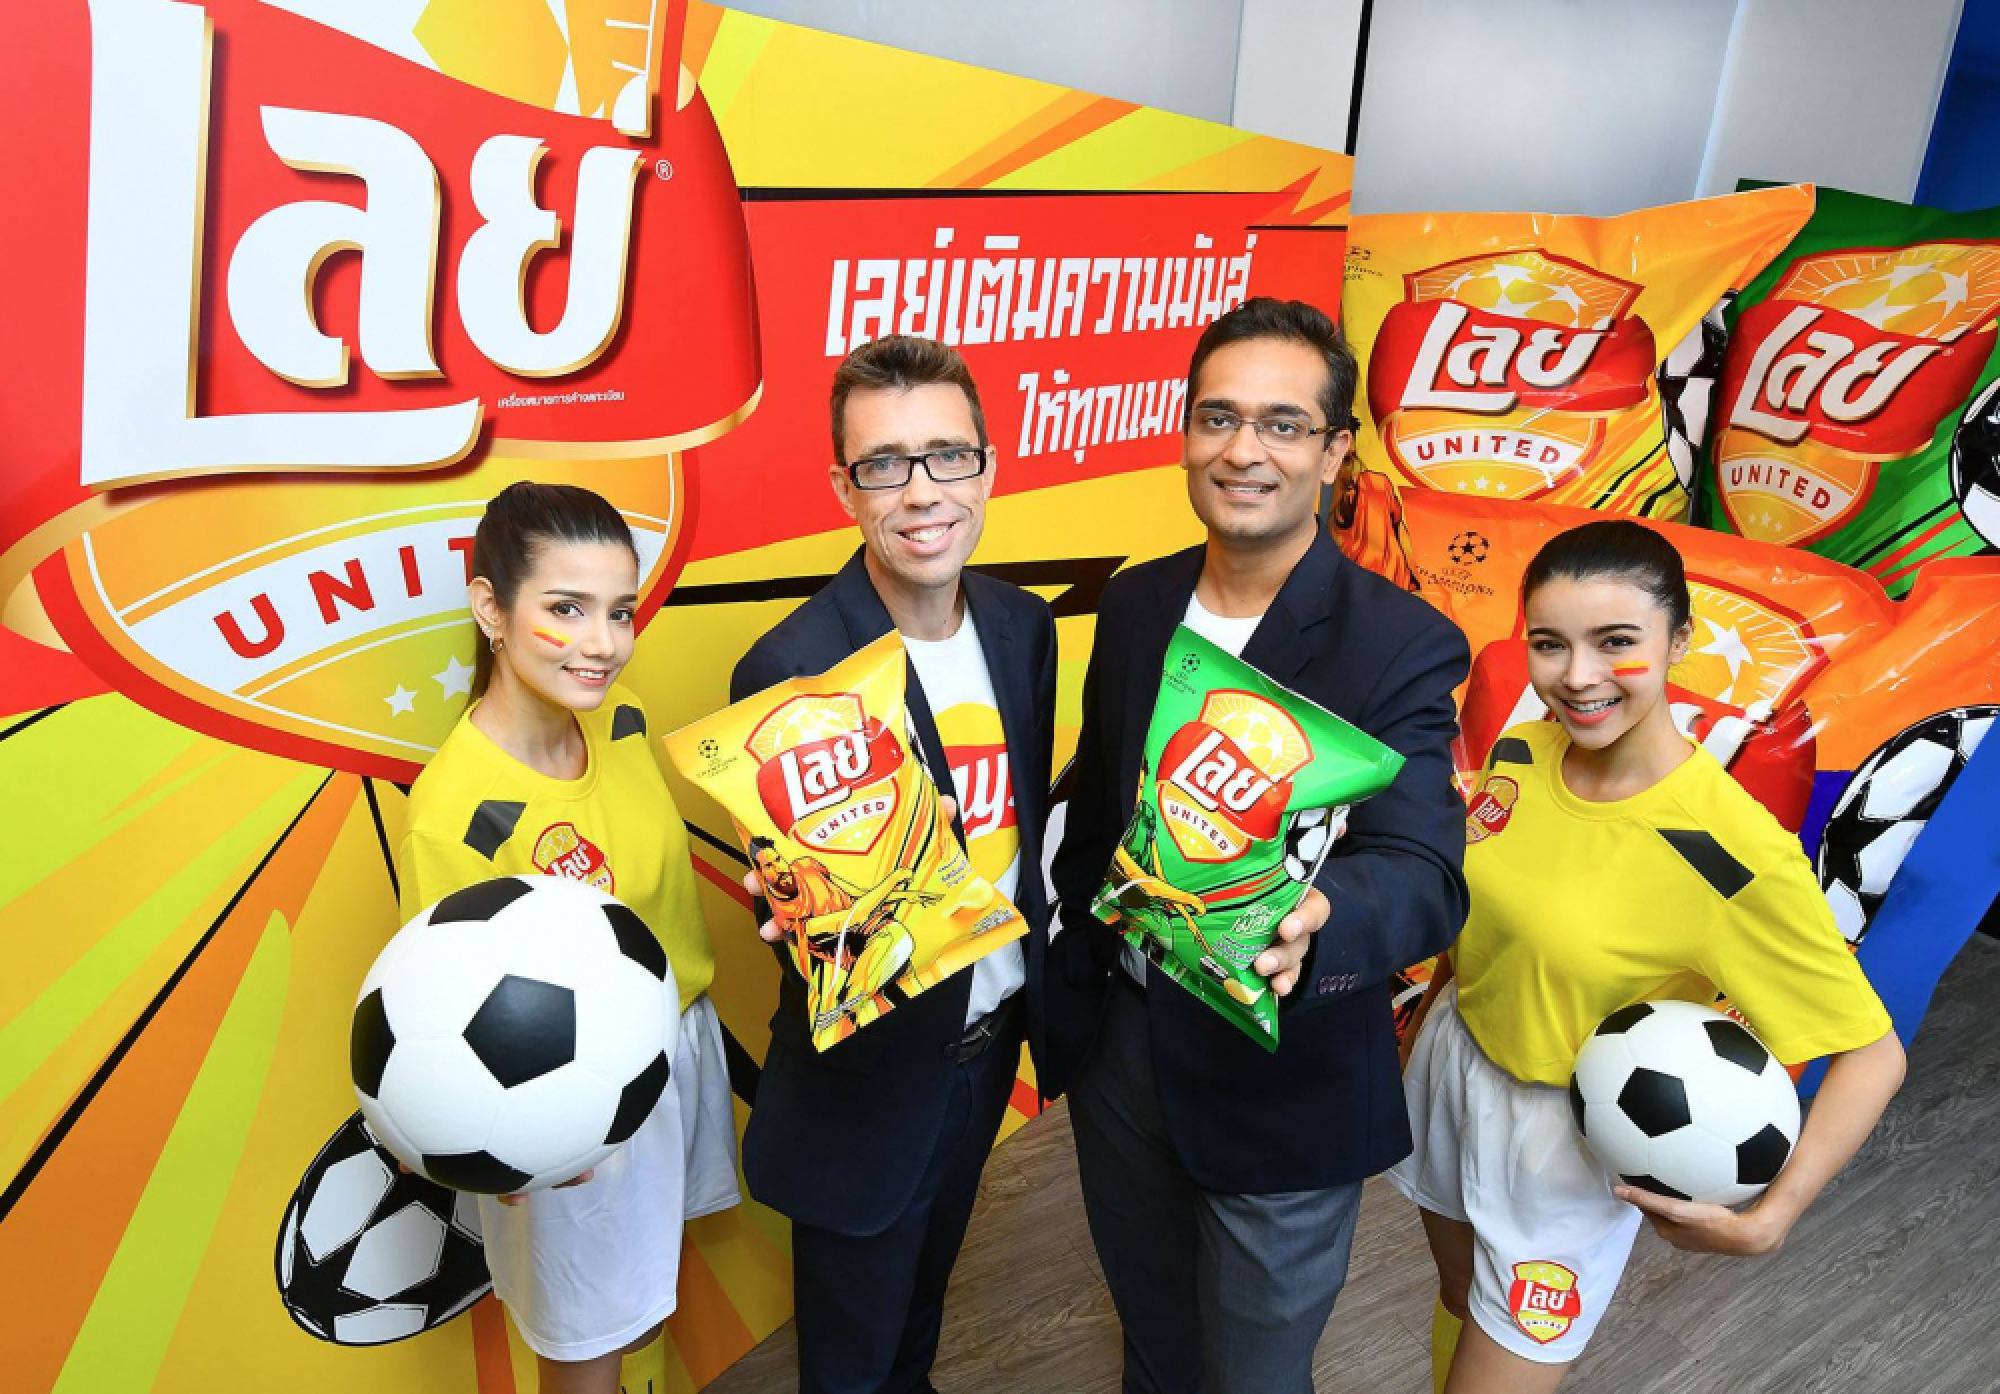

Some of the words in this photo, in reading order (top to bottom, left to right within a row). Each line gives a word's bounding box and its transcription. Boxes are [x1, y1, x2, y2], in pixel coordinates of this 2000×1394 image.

[1017, 368, 1190, 464] ให้ทุกแมท
[1416, 434, 1561, 464] UNITED
[1731, 464, 1831, 510] UNITED
[213, 535, 476, 659] UNIT
[815, 800, 886, 840] UNITED
[1169, 803, 1229, 851] UNITED
